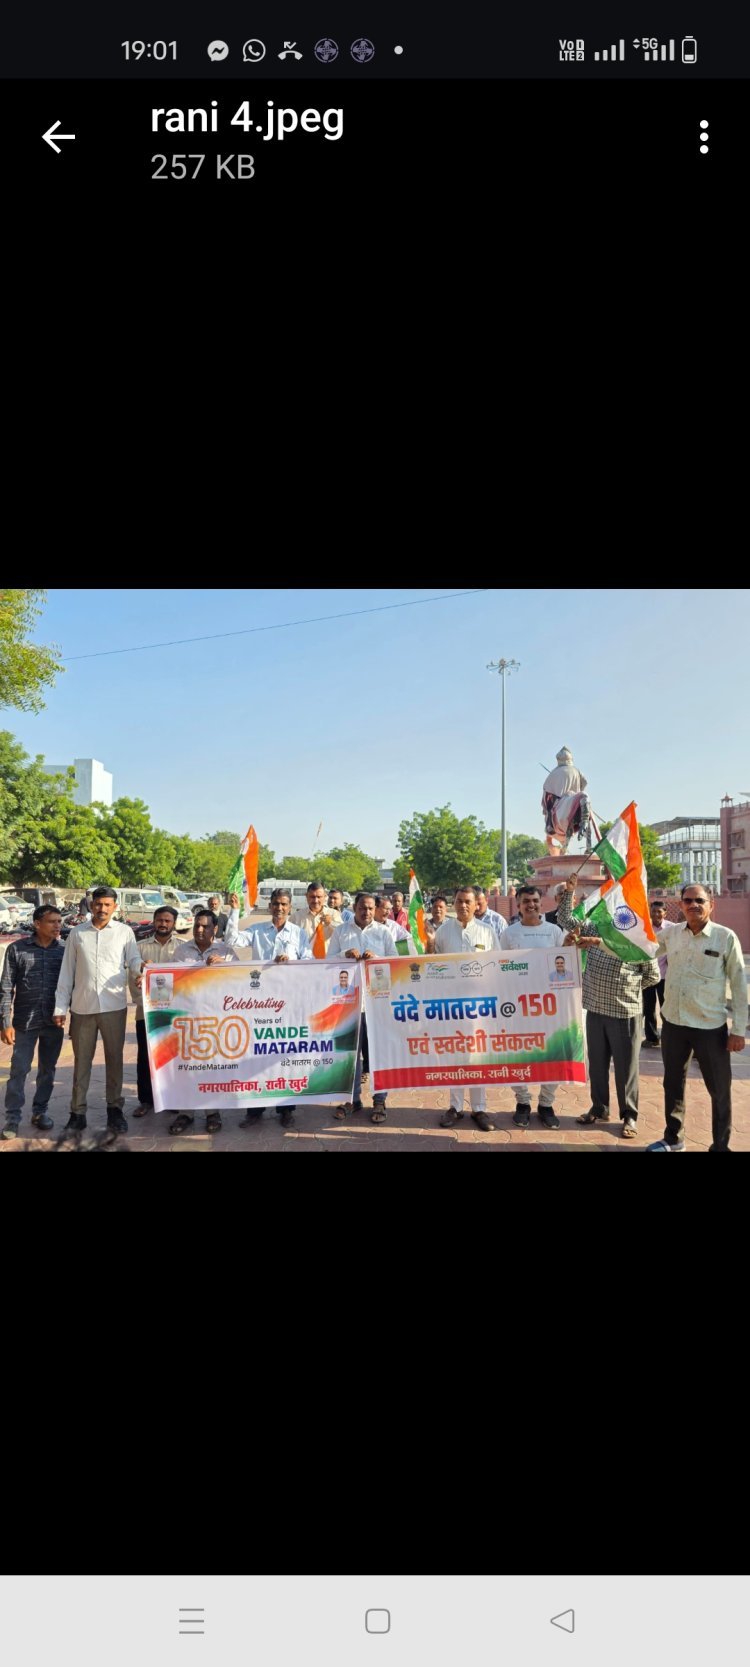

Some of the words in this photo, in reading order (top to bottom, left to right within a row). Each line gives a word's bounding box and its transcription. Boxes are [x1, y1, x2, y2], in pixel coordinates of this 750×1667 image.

[121, 40, 177, 60] 19:01
[642, 38, 658, 49] 5G
[151, 100, 218, 132] rani
[230, 100, 344, 141] 4.jpeg
[151, 154, 205, 179] 257
[216, 154, 255, 179] KB
[223, 995, 286, 1013] Celebrating
[391, 993, 420, 1023] वंदे
[423, 996, 498, 1021] मातरम
[500, 1001, 516, 1018] @
[518, 993, 557, 1017] 150
[254, 1017, 272, 1025] Years
[274, 1016, 282, 1024] of
[173, 1015, 250, 1060] 150
[254, 1026, 309, 1040] VANDE
[254, 1040, 333, 1055] MATARAM
[406, 1031, 431, 1056] एवं
[432, 1029, 488, 1055] स्वदेशी
[490, 1029, 546, 1053] संकल्प
[178, 1063, 239, 1071] #VandeMataram
[280, 1058, 291, 1067] वंदे
[292, 1058, 312, 1066] मातरम
[488, 1066, 510, 1078] रानी
[511, 1065, 531, 1081] खुर्द
[198, 1078, 262, 1094] नगरपालिका,
[265, 1077, 286, 1091] रानी
[289, 1076, 309, 1092] खुर्द
